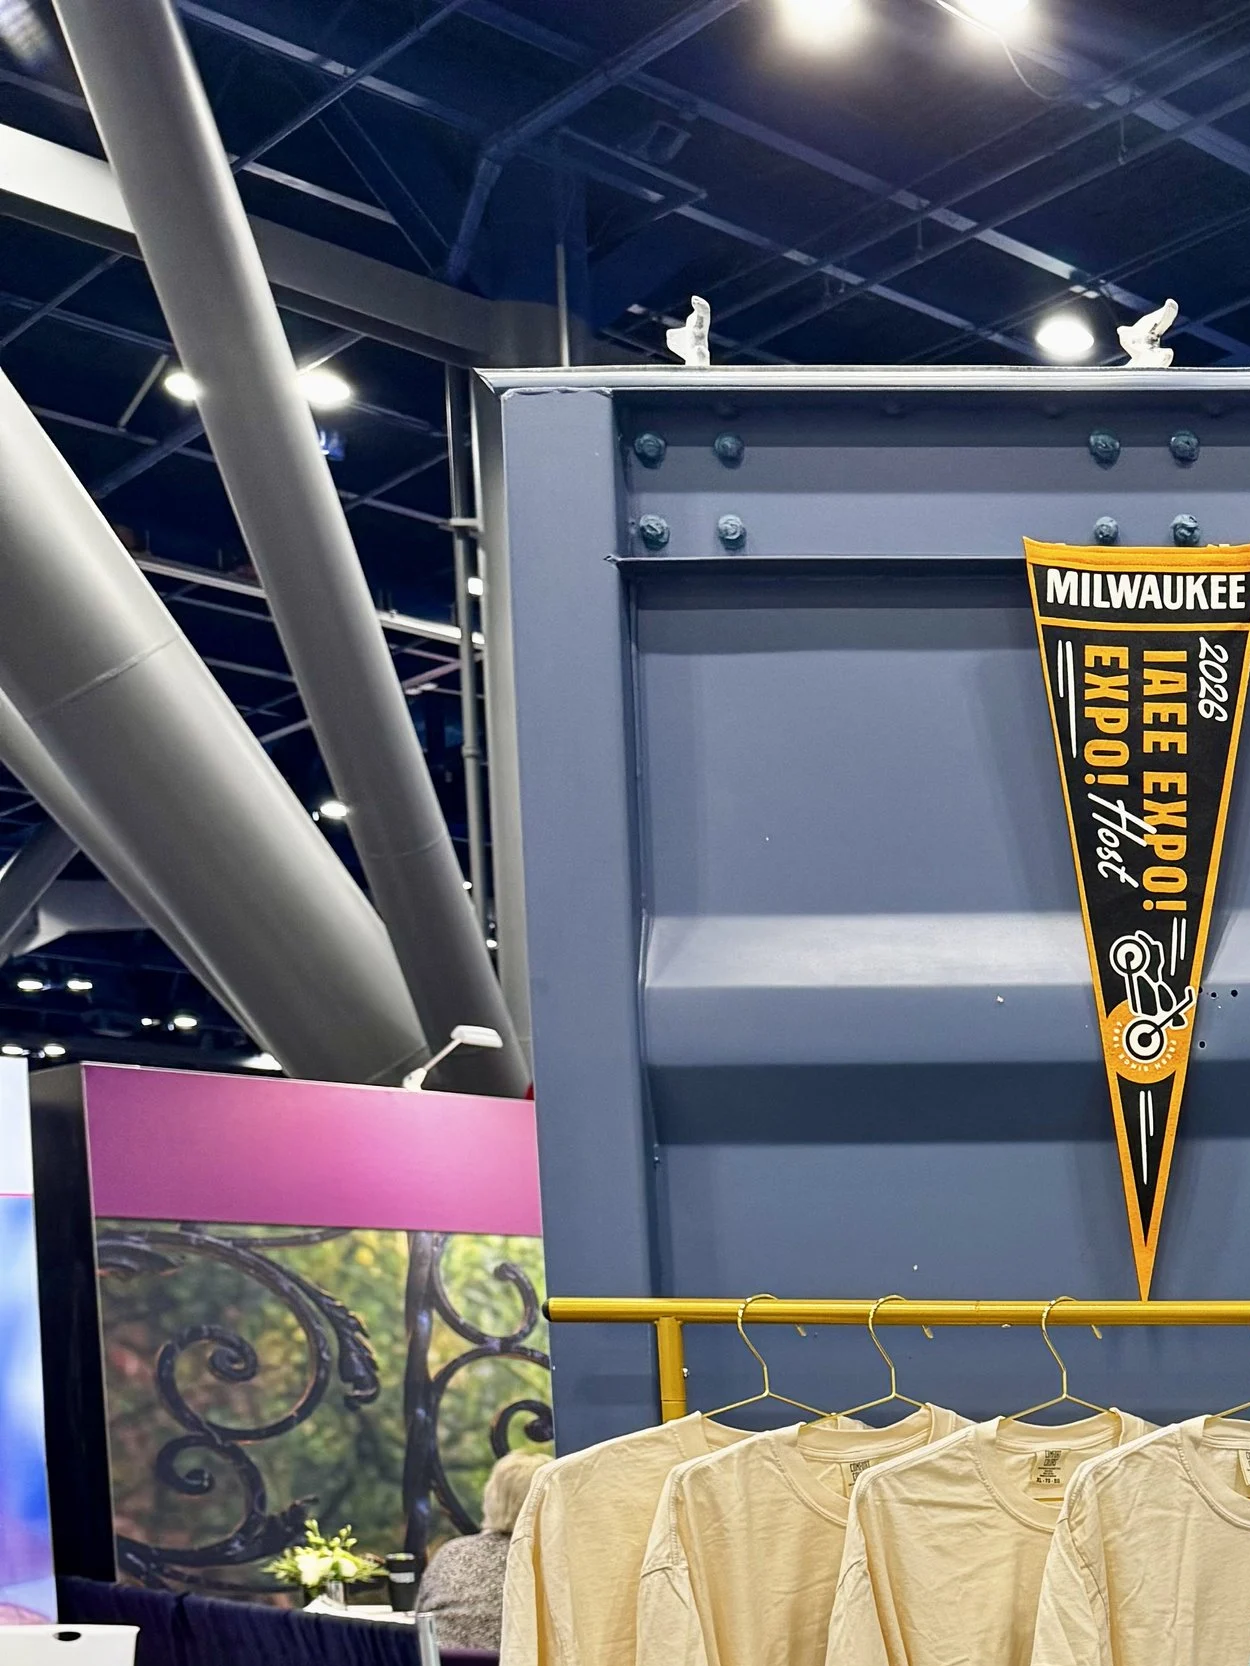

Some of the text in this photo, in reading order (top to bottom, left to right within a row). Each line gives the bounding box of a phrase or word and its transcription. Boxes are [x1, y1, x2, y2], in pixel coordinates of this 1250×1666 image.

[1047, 568, 1246, 611] MILWAUKEE
[1084, 645, 1130, 785] EXPO!
[1198, 636, 1229, 722] 2026
[1142, 650, 1188, 911] IAEE EXPO!
[1087, 792, 1157, 889] Host
